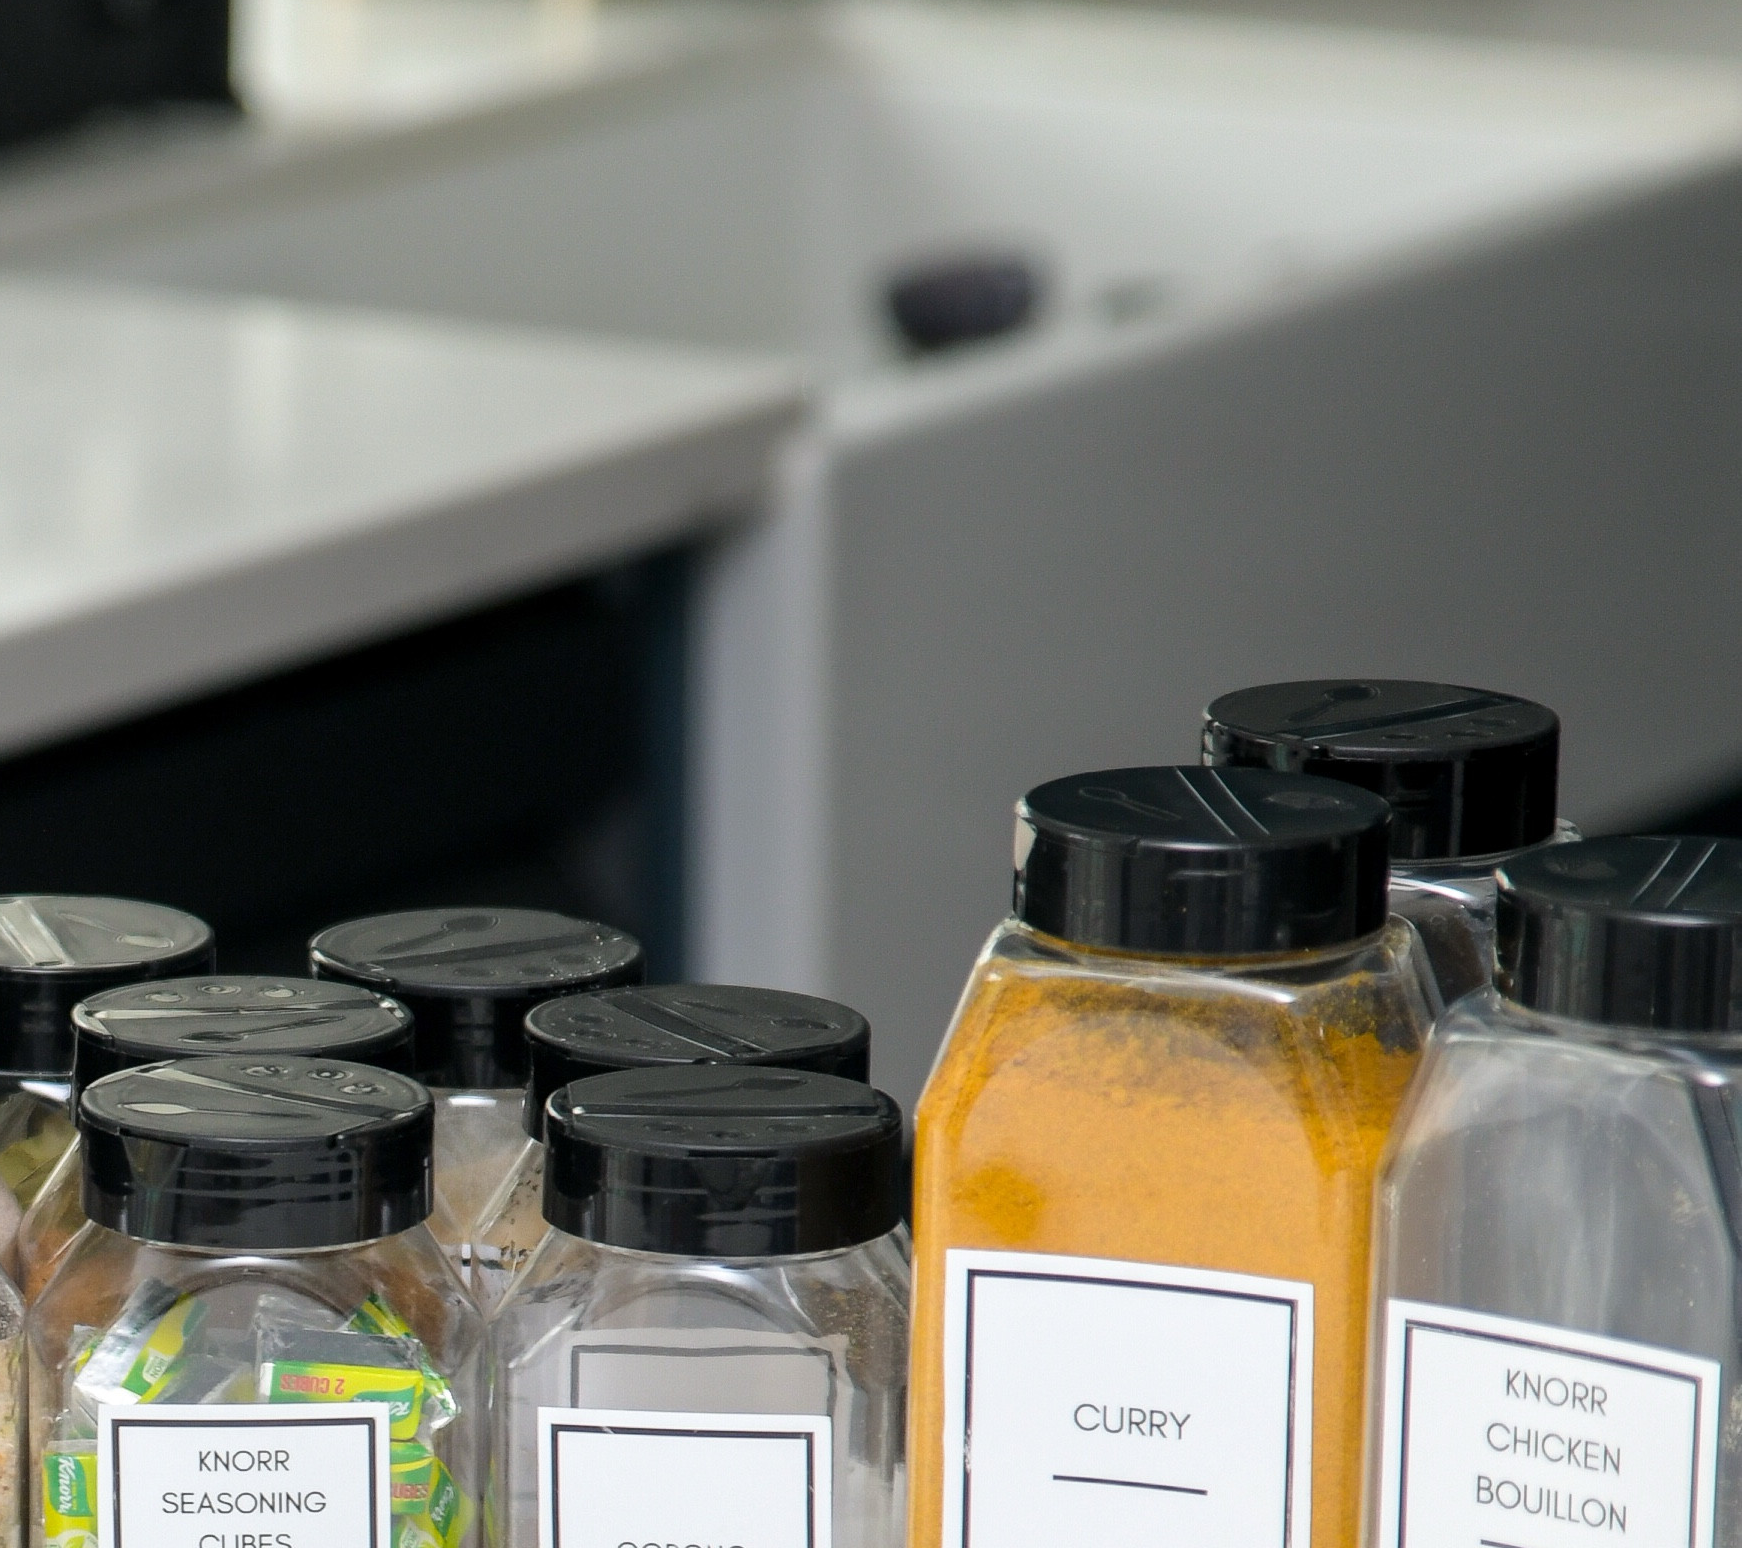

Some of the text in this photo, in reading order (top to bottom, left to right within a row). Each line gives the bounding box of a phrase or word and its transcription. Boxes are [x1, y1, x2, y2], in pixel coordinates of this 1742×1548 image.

[280, 1373, 345, 1395] 2 CUBES
[1505, 1368, 1608, 1417] KNORR
[1073, 1403, 1192, 1441] CURRY
[198, 1449, 290, 1473] KNORR
[1485, 1422, 1621, 1477] CHICKEN
[58, 1455, 76, 1514] Knorr
[161, 1490, 327, 1515] SEASONING
[1476, 1474, 1627, 1534] BOUILLON
